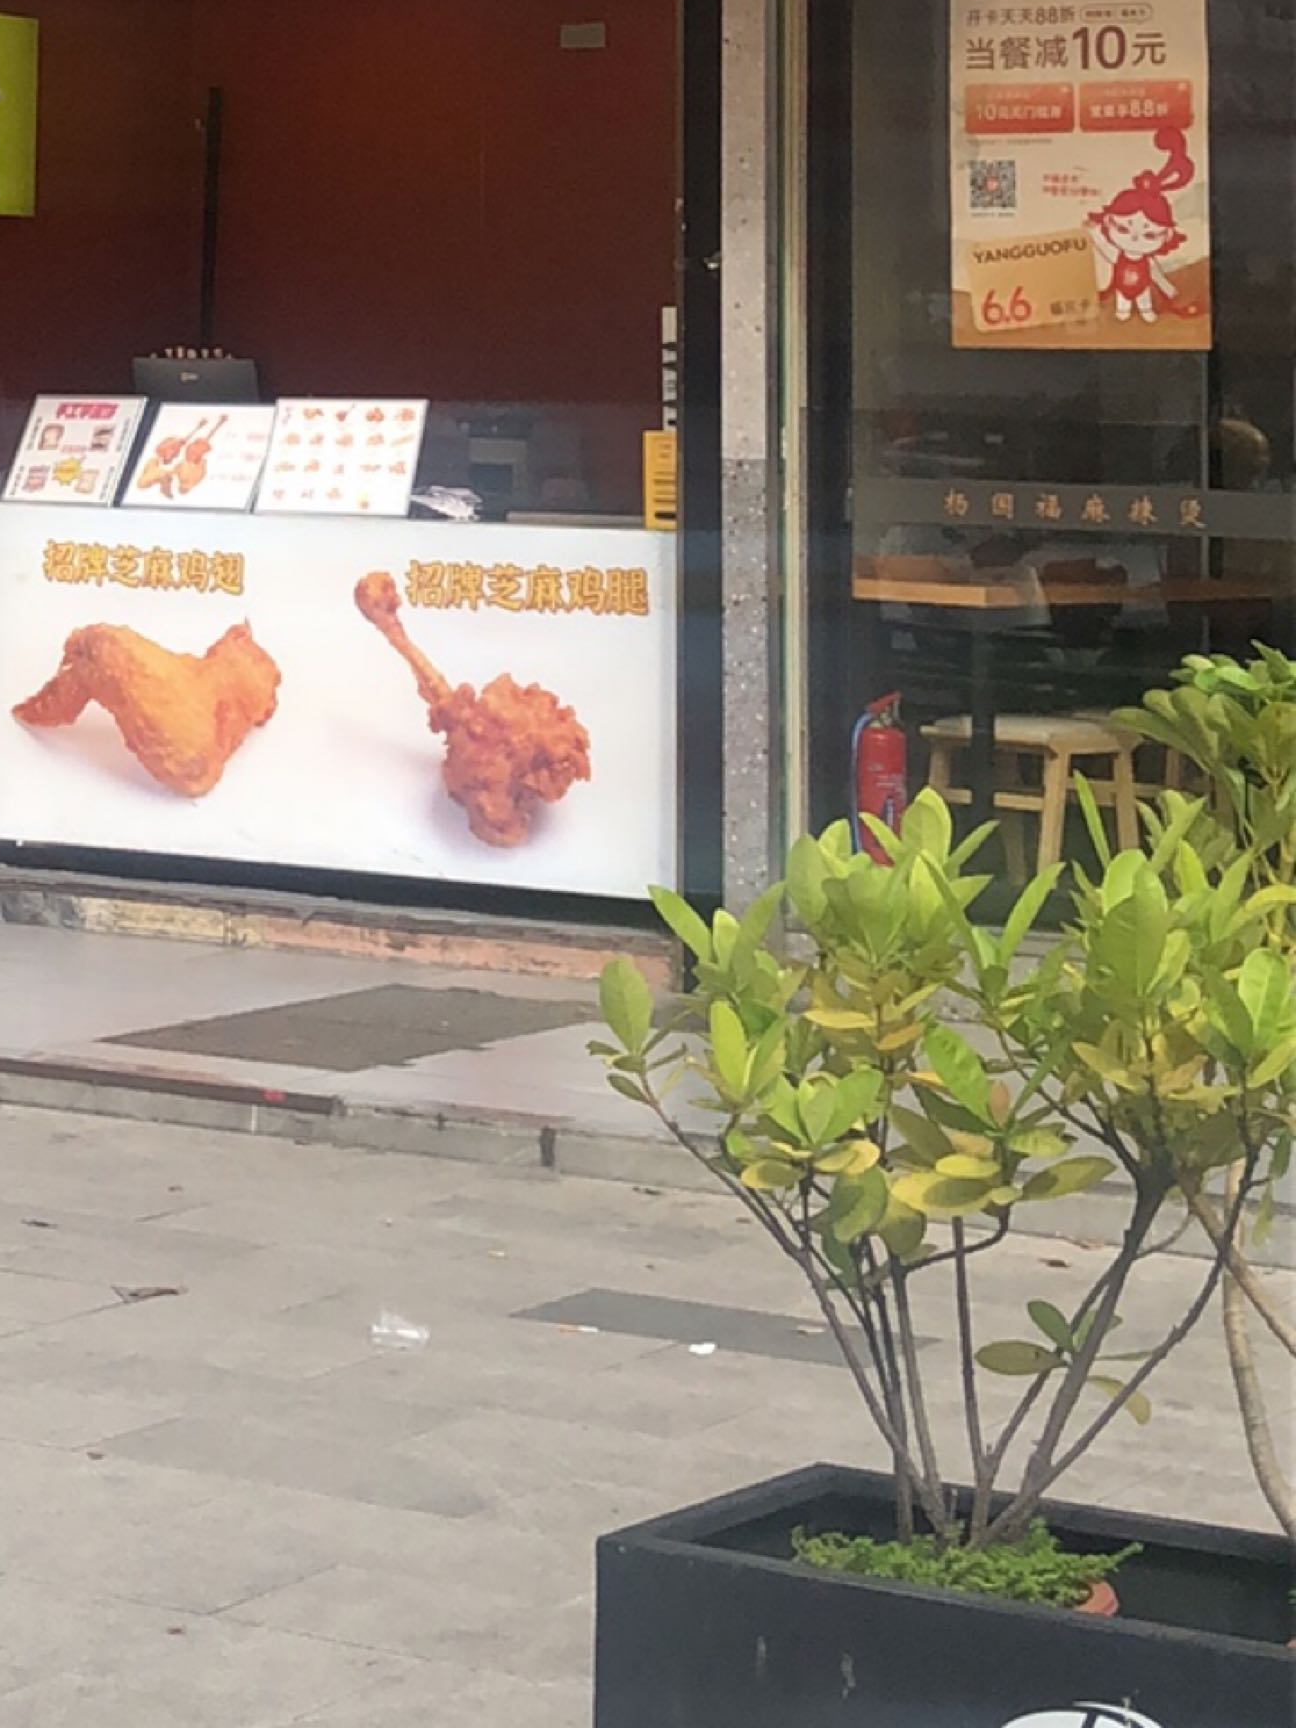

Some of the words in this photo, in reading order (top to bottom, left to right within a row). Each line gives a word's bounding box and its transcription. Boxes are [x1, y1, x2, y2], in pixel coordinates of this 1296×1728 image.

[964, 24, 1167, 71] 当餐减10元
[972, 236, 1089, 265] YANGGUOFU
[979, 284, 1034, 326] 6.6
[42, 538, 245, 597] 招牌芝麻鸡翅
[404, 559, 650, 617] 招牌芝麻鸡腿
